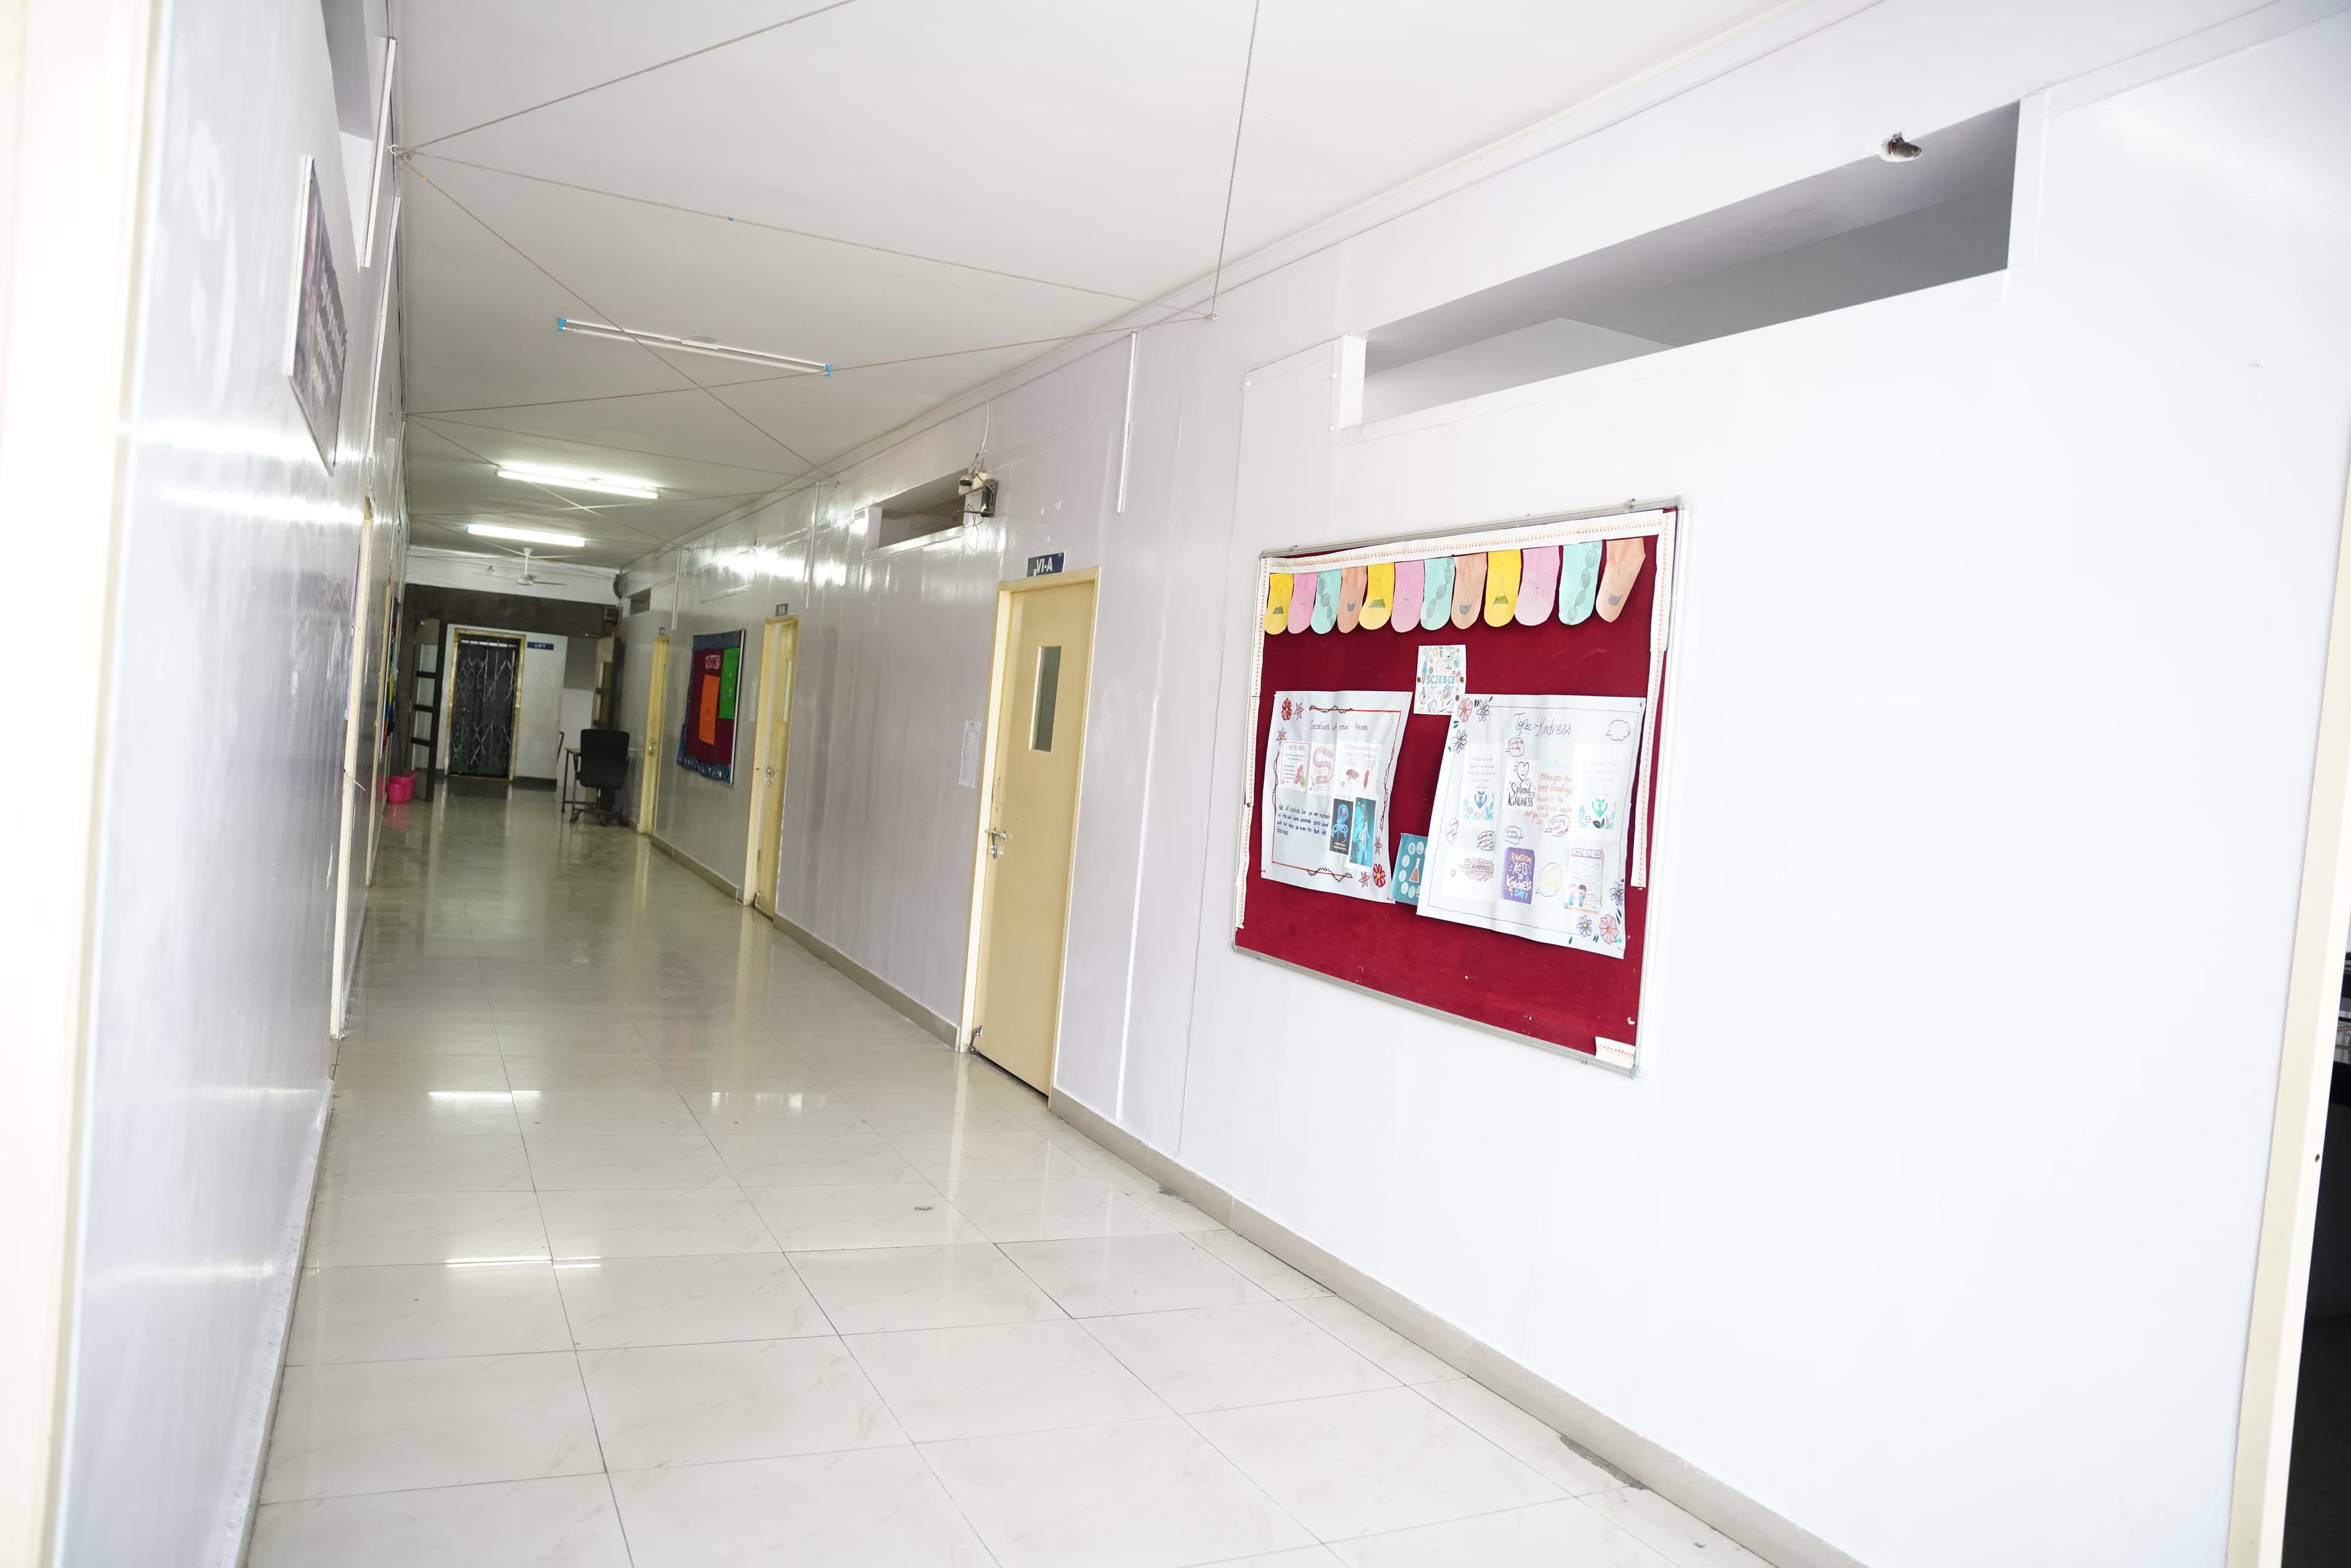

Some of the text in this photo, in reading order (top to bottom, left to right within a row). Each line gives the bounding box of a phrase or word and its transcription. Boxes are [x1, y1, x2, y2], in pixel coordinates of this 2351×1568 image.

[1036, 557, 1052, 573] VI-A
[1427, 674, 1455, 685] SCIENCE
[1511, 852, 1532, 864] RANDOM
[1572, 849, 1601, 858] KINDNESS
[1472, 862, 1491, 871] kindness
[1512, 861, 1528, 876] ACTS
[1514, 889, 1525, 899] DAY
